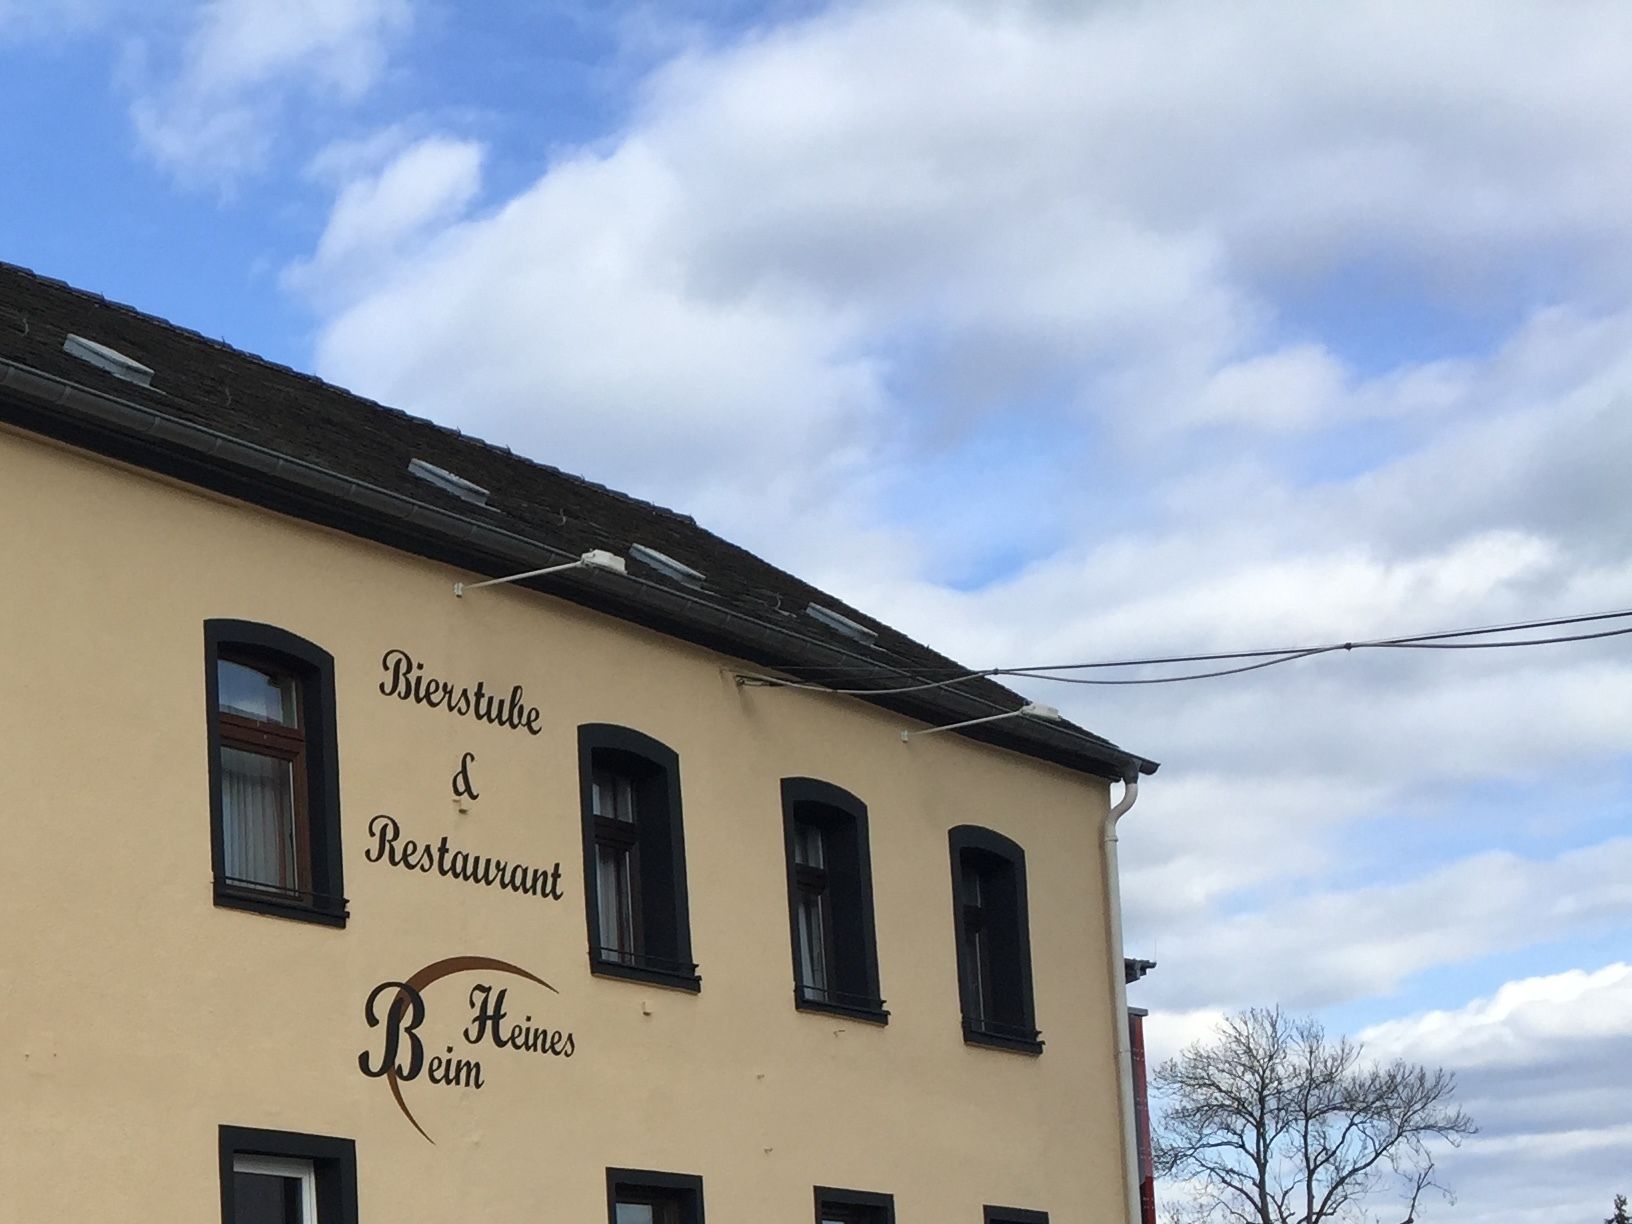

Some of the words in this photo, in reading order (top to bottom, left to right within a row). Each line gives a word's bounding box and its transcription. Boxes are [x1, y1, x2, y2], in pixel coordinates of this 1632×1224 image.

[379, 649, 542, 735] Bierstube
[452, 752, 479, 800] &
[365, 815, 564, 901] Restaurant
[358, 981, 485, 1090] Beim
[463, 983, 576, 1058] Heines
